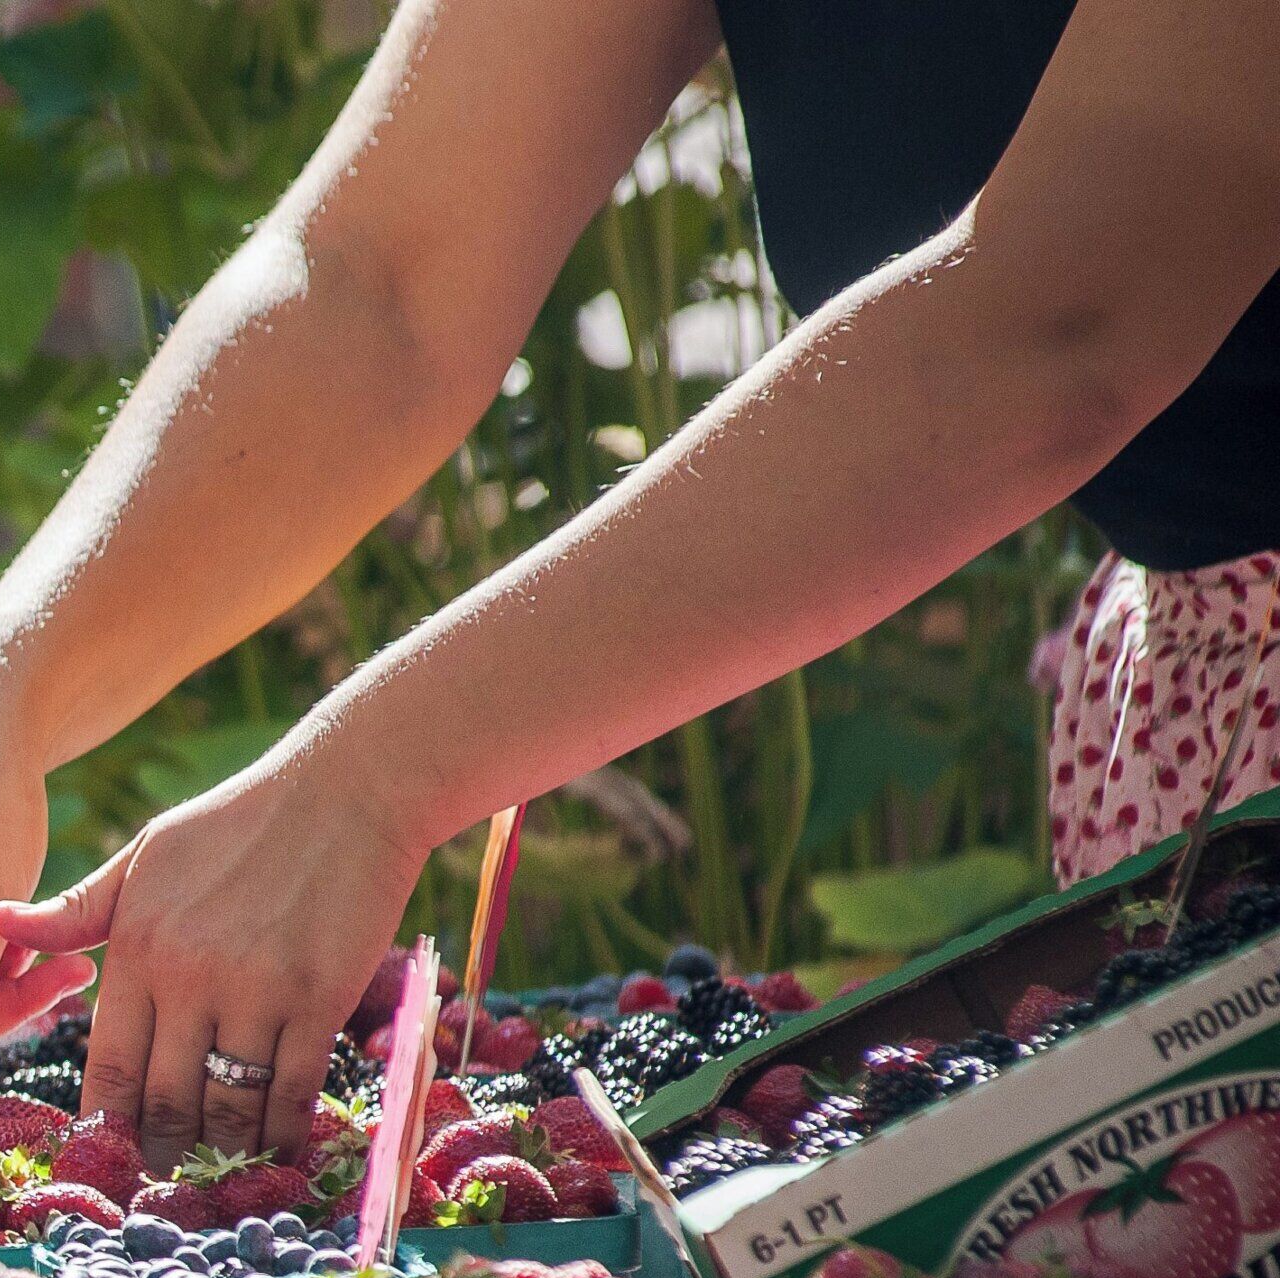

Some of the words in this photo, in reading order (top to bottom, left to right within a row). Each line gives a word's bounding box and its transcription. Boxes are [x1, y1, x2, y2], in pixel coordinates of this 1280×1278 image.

[1152, 967, 1280, 1060] PRODUC
[751, 1219, 802, 1264] 6-1
[806, 1194, 847, 1235] PT
[968, 1163, 1067, 1264] RESH
